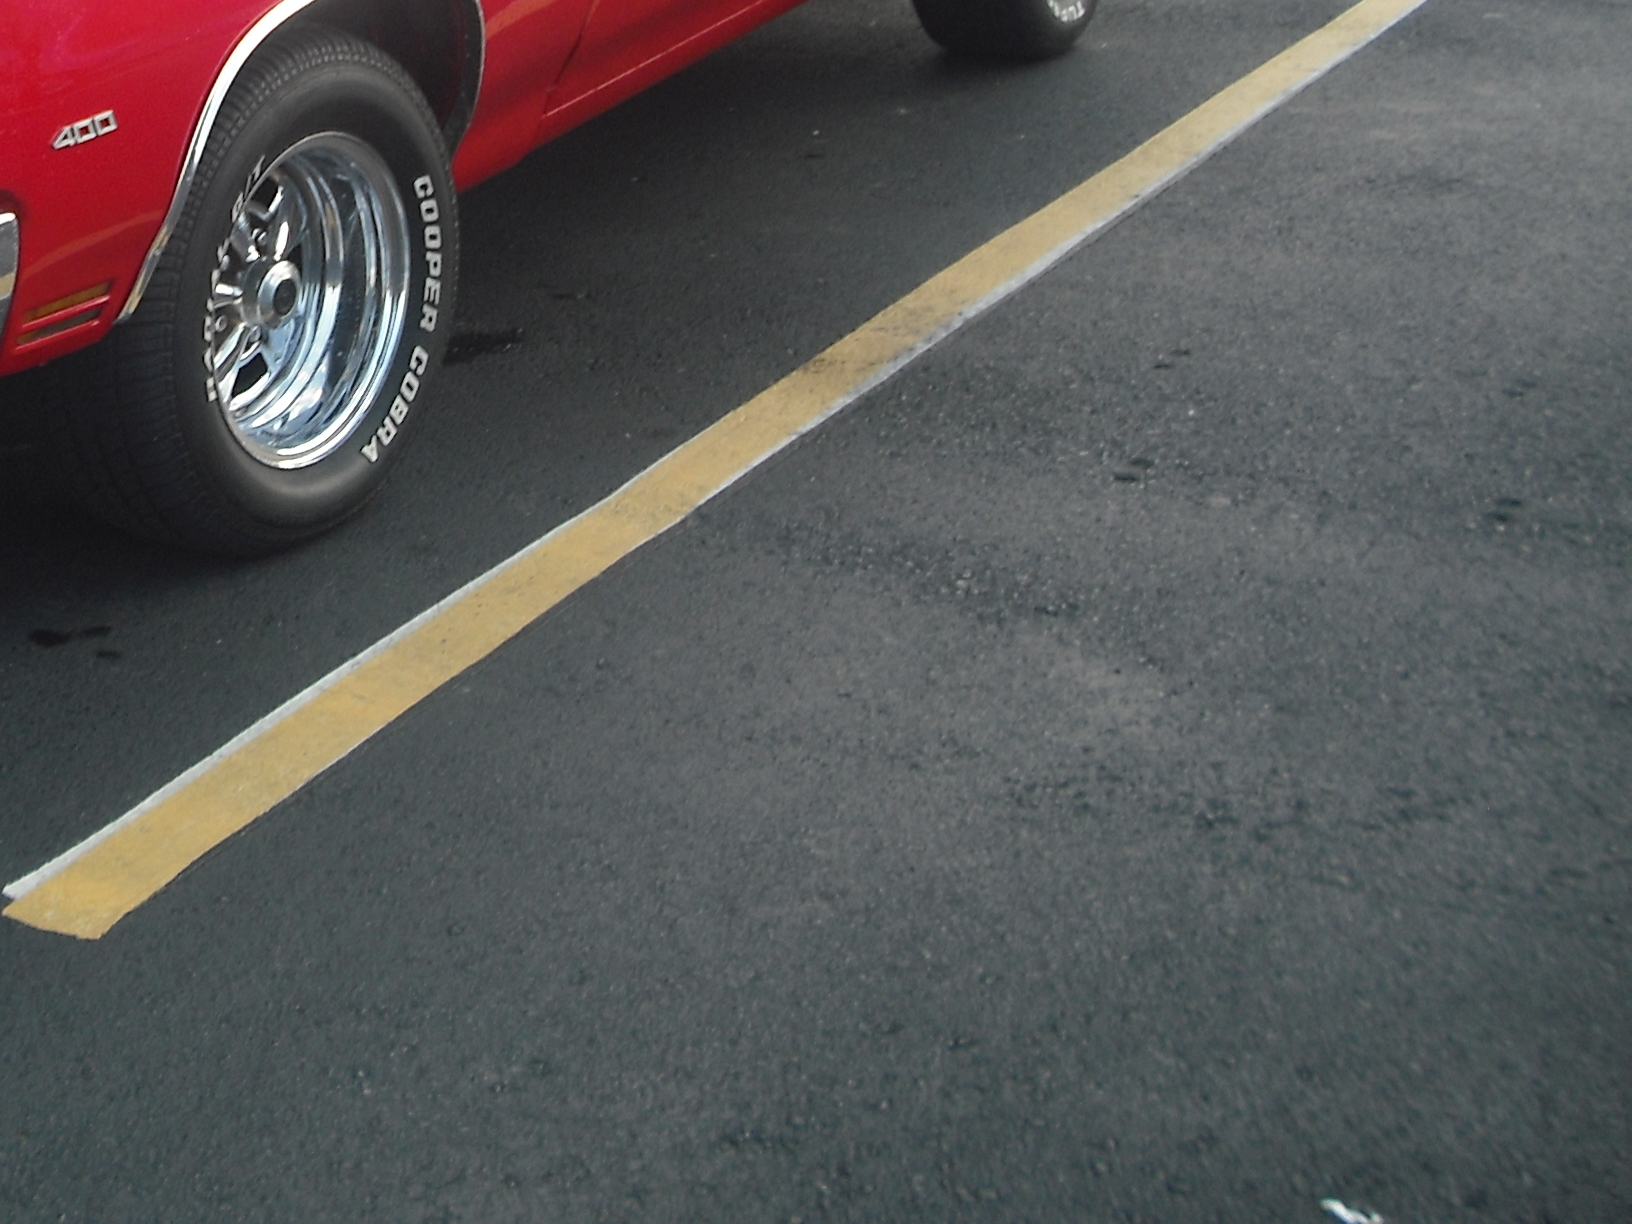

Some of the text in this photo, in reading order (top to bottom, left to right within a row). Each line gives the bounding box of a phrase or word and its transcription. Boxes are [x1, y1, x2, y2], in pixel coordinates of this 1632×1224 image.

[52, 109, 118, 150] 400
[361, 175, 443, 463] COOPER COBRA
